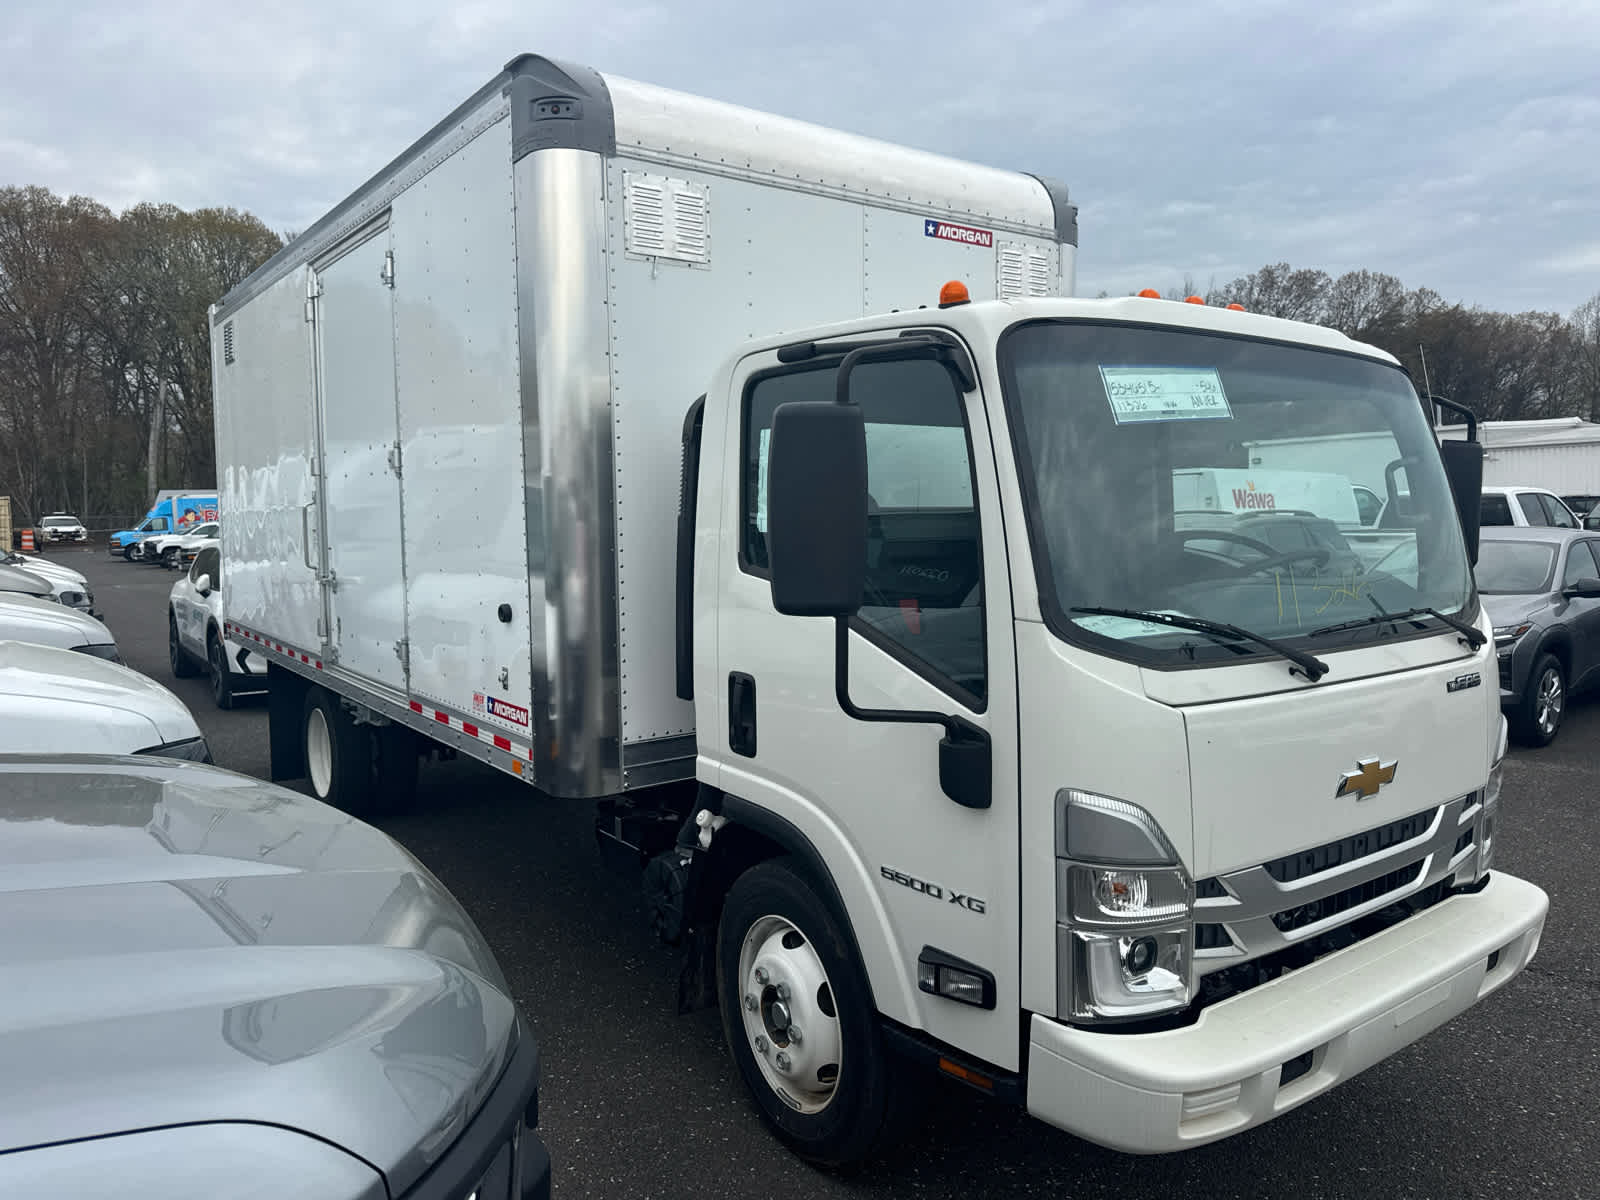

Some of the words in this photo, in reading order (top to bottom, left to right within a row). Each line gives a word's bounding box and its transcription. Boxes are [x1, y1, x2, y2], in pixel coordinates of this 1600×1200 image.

[937, 224, 991, 246] MORGAN
[1231, 488, 1275, 509] Wawa
[493, 700, 528, 725] MORGAN
[880, 866, 943, 900] 5500
[948, 890, 986, 914] XG
